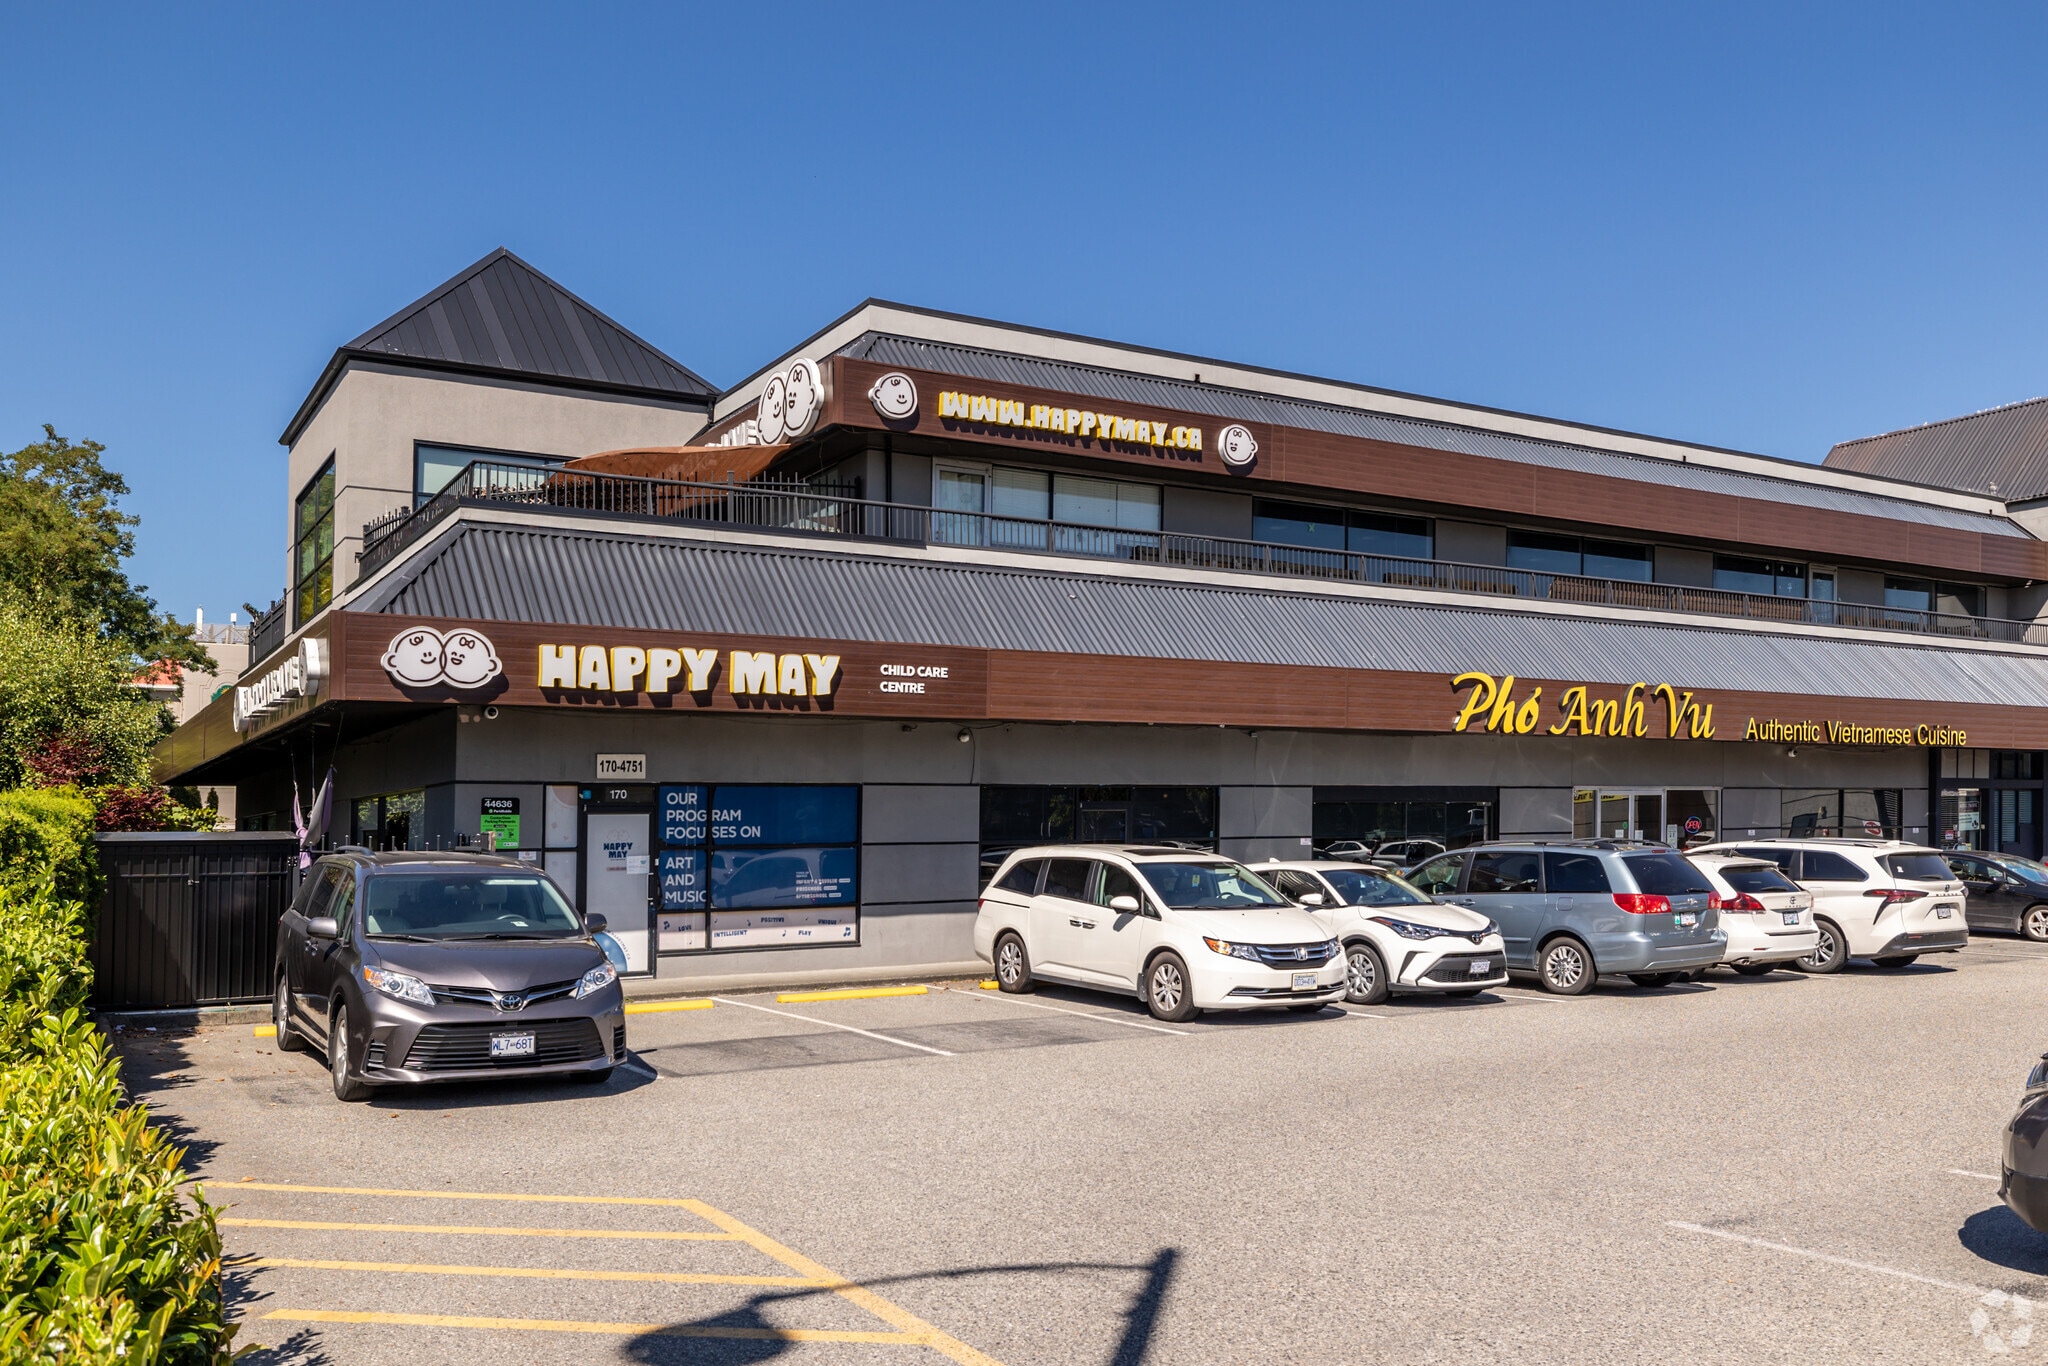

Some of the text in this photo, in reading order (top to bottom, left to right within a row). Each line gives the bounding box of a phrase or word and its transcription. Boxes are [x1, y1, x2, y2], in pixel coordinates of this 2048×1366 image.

[939, 391, 1202, 450] WWW.HAPPYMAY.CA
[538, 644, 841, 696] HAPPY MAY
[880, 664, 949, 679] CHILD CARE
[880, 681, 926, 694] CENTRE
[1549, 682, 1648, 737] Anh
[1652, 683, 1716, 739] Vu
[1745, 717, 1967, 746] Authentic Vietnamese Cuisine
[599, 760, 643, 773] 170-4751
[609, 789, 628, 800] 170
[666, 792, 698, 805] OUR
[484, 800, 513, 808] 44636
[666, 809, 742, 822] PROGRAM
[1686, 820, 1701, 830] OPEN
[666, 825, 761, 839] FOCUSES ON
[603, 842, 634, 851] HAPPY
[608, 851, 628, 859] MAY
[665, 857, 694, 869] ART
[665, 874, 695, 887] AND
[665, 890, 707, 903] MUSIC
[678, 924, 692, 932] LOVE
[713, 930, 748, 938] INTELLIGENT
